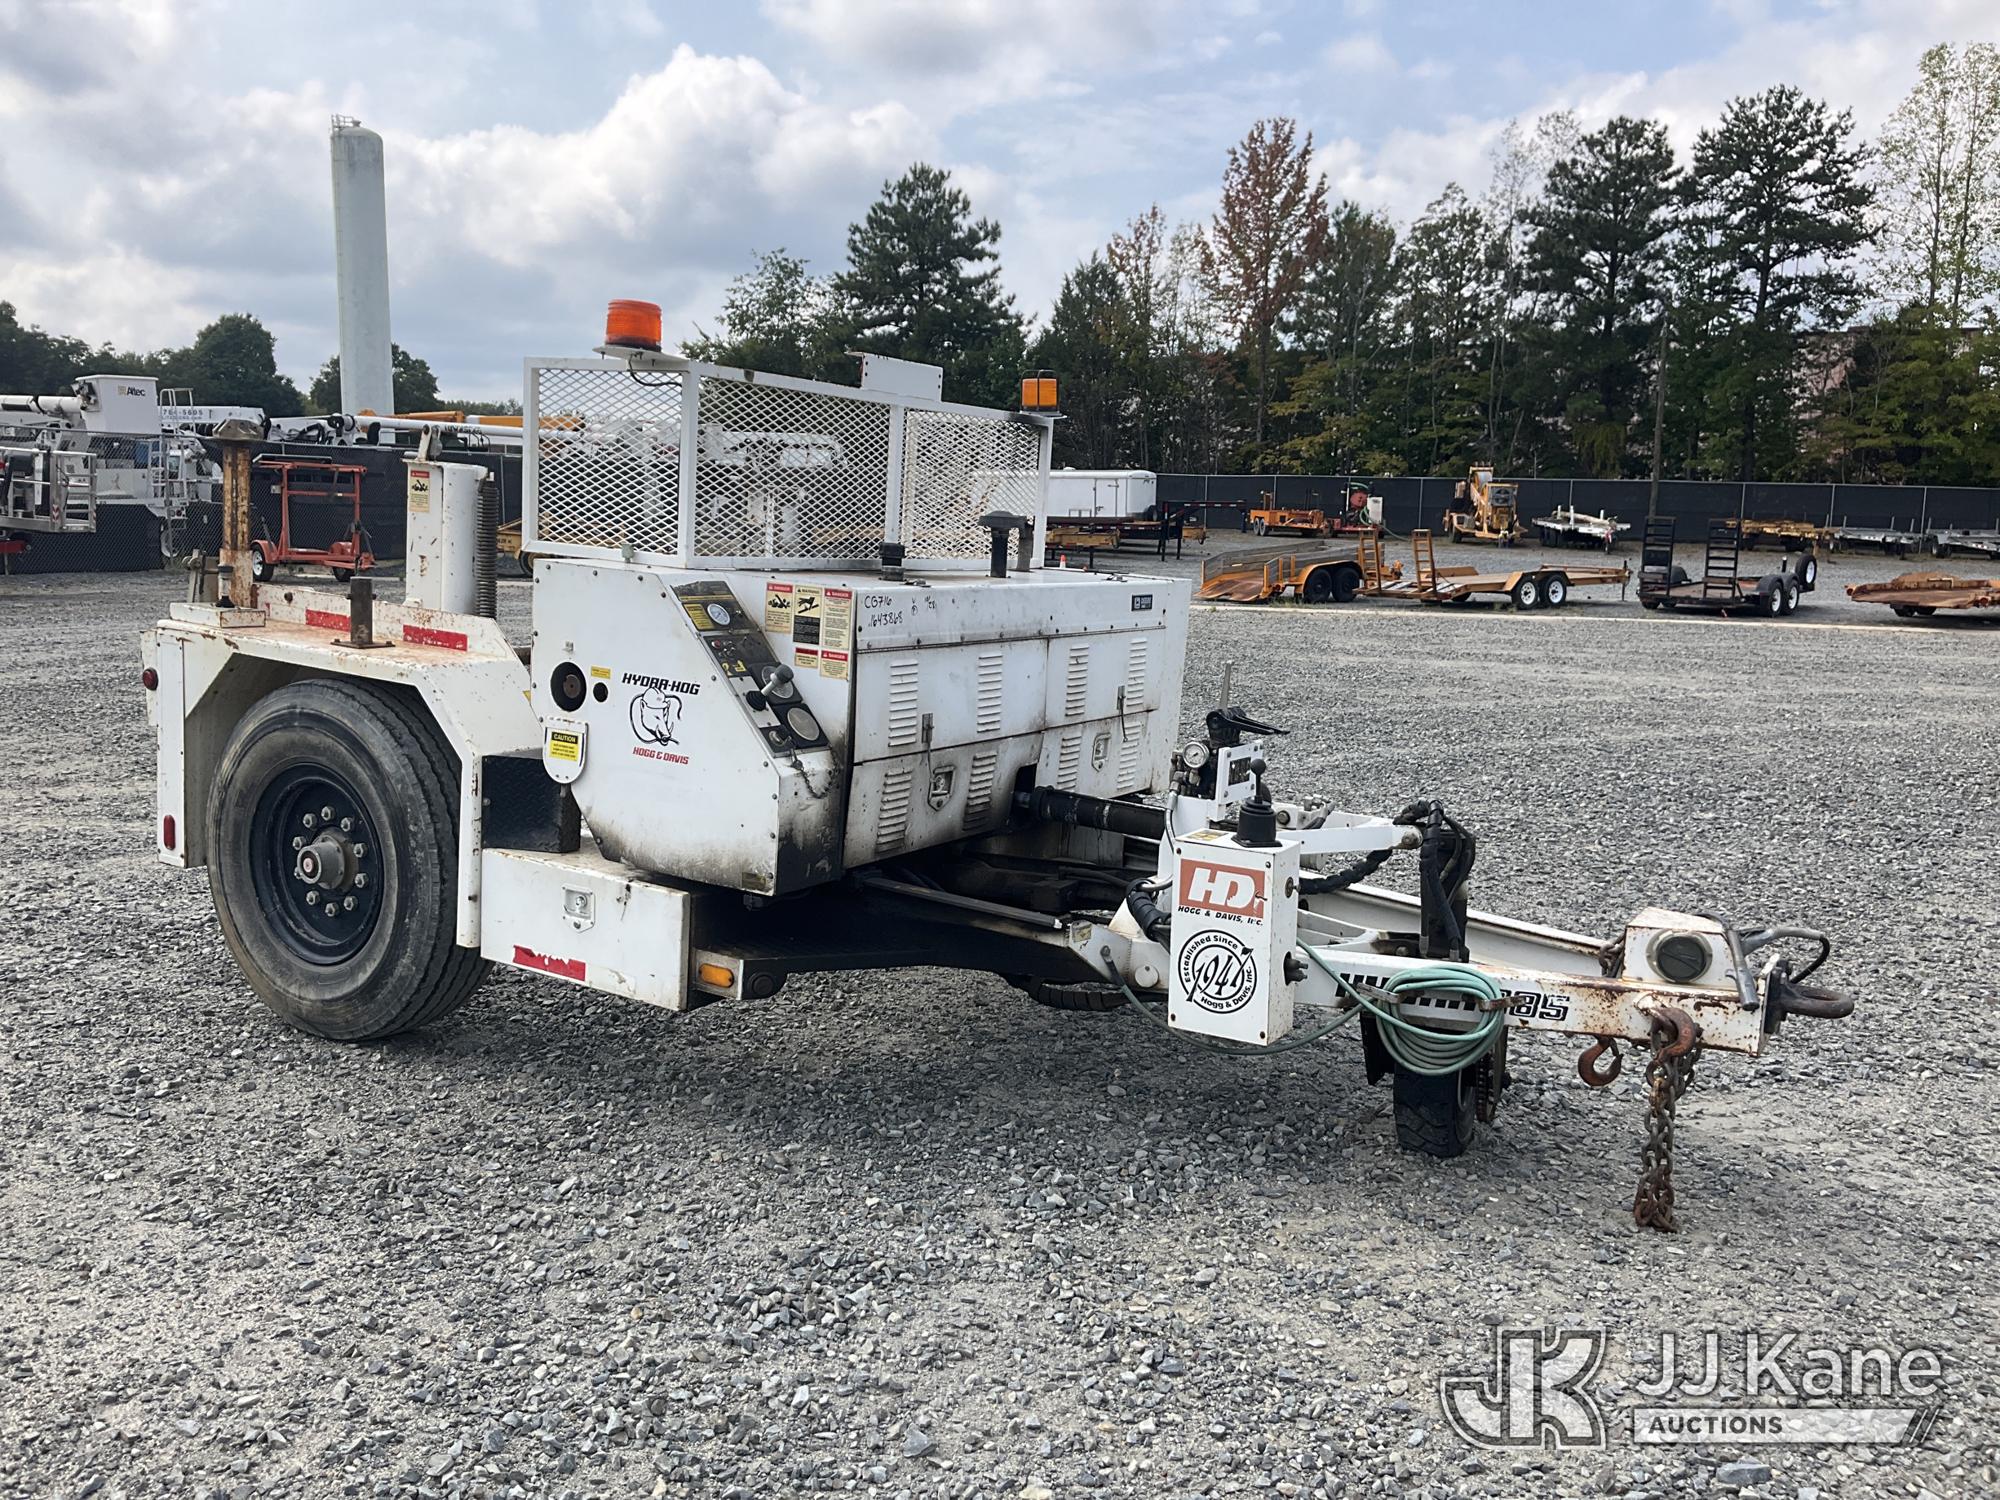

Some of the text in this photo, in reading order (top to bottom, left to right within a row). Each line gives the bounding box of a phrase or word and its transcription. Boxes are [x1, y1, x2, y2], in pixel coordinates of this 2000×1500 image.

[127, 386, 146, 396] Altec
[622, 672, 700, 695] HYDRA-HOG
[553, 733, 576, 743] CAUTION
[632, 747, 690, 765] HOGG & DAVIS
[1178, 905, 1201, 915] HOGG
[1215, 912, 1243, 923] DAVIS,
[1183, 935, 1238, 983] Established Since
[1200, 996, 1224, 1009] Hogg
[1232, 985, 1252, 1005] Davis,
[1245, 966, 1253, 983] Inc.
